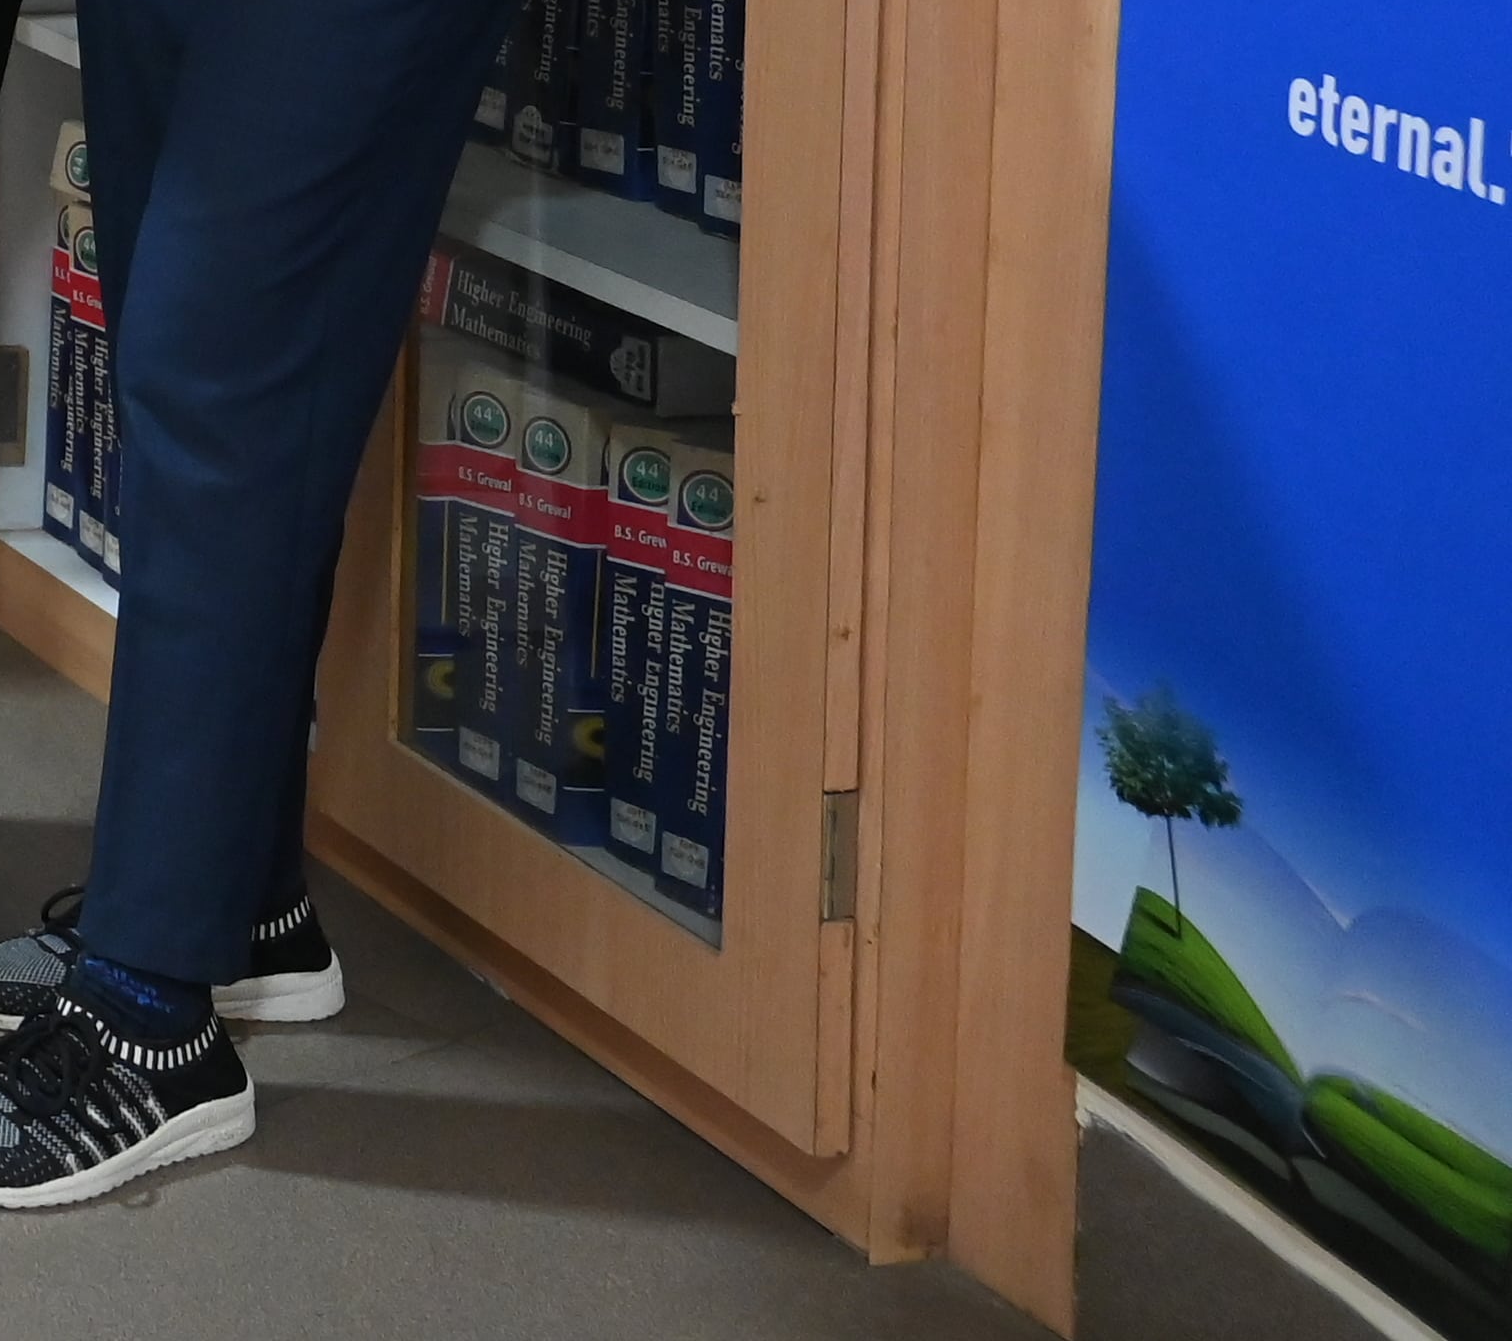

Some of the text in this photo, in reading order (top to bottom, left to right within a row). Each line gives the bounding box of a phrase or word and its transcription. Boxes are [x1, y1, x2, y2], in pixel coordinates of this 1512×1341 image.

[676, 5, 703, 128] Engineering
[1287, 73, 1512, 206] eternal.
[48, 303, 67, 411] Mathematics
[451, 302, 541, 360] Mathematics
[457, 269, 593, 353] Higher Engineering
[73, 327, 89, 435] Mathematics
[89, 335, 110, 501] Higher Engineering
[476, 472, 512, 493] Grewal
[536, 498, 572, 520] Grewal
[614, 524, 667, 548] B.S. Grew
[458, 511, 478, 638] Mathematics
[479, 520, 509, 715] Higher Engineering
[516, 538, 537, 668] Mathematics
[672, 549, 694, 567] B.S.
[534, 548, 568, 747] Higher Engineering
[611, 572, 637, 704] Mathematics
[666, 598, 695, 735] Mathematics
[687, 607, 732, 817] Higher Engineering
